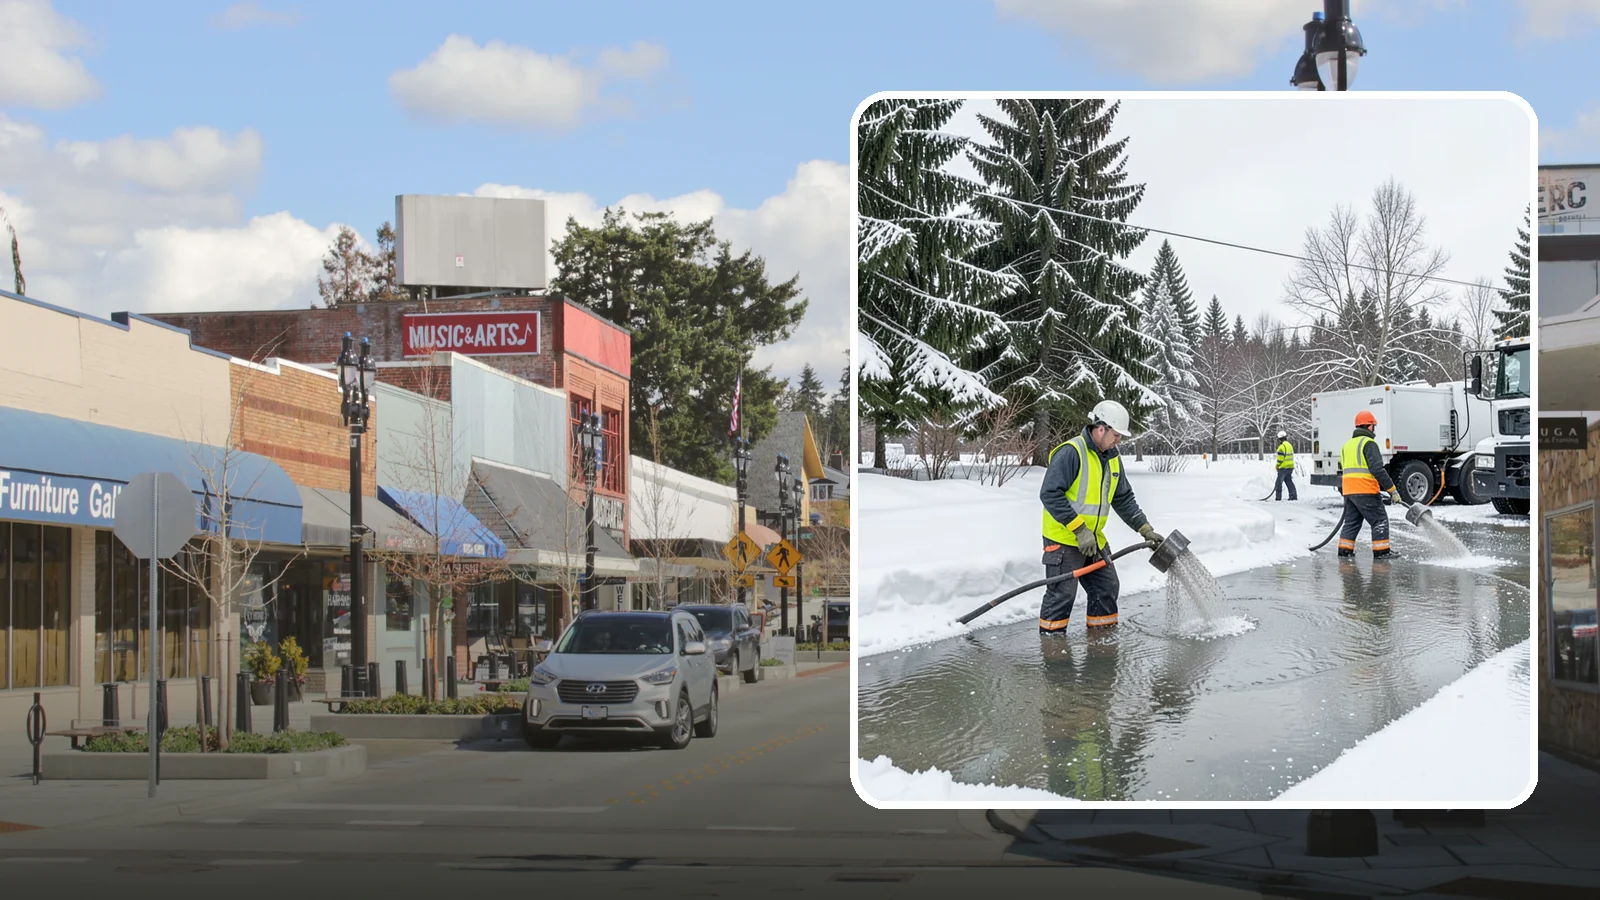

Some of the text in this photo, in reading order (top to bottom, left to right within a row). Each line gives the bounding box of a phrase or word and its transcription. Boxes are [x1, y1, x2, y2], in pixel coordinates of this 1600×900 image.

[409, 323, 520, 349] MUSIC&ARTS
[0, 471, 122, 519] Furniture Gal
[453, 563, 479, 574] SUSHI
